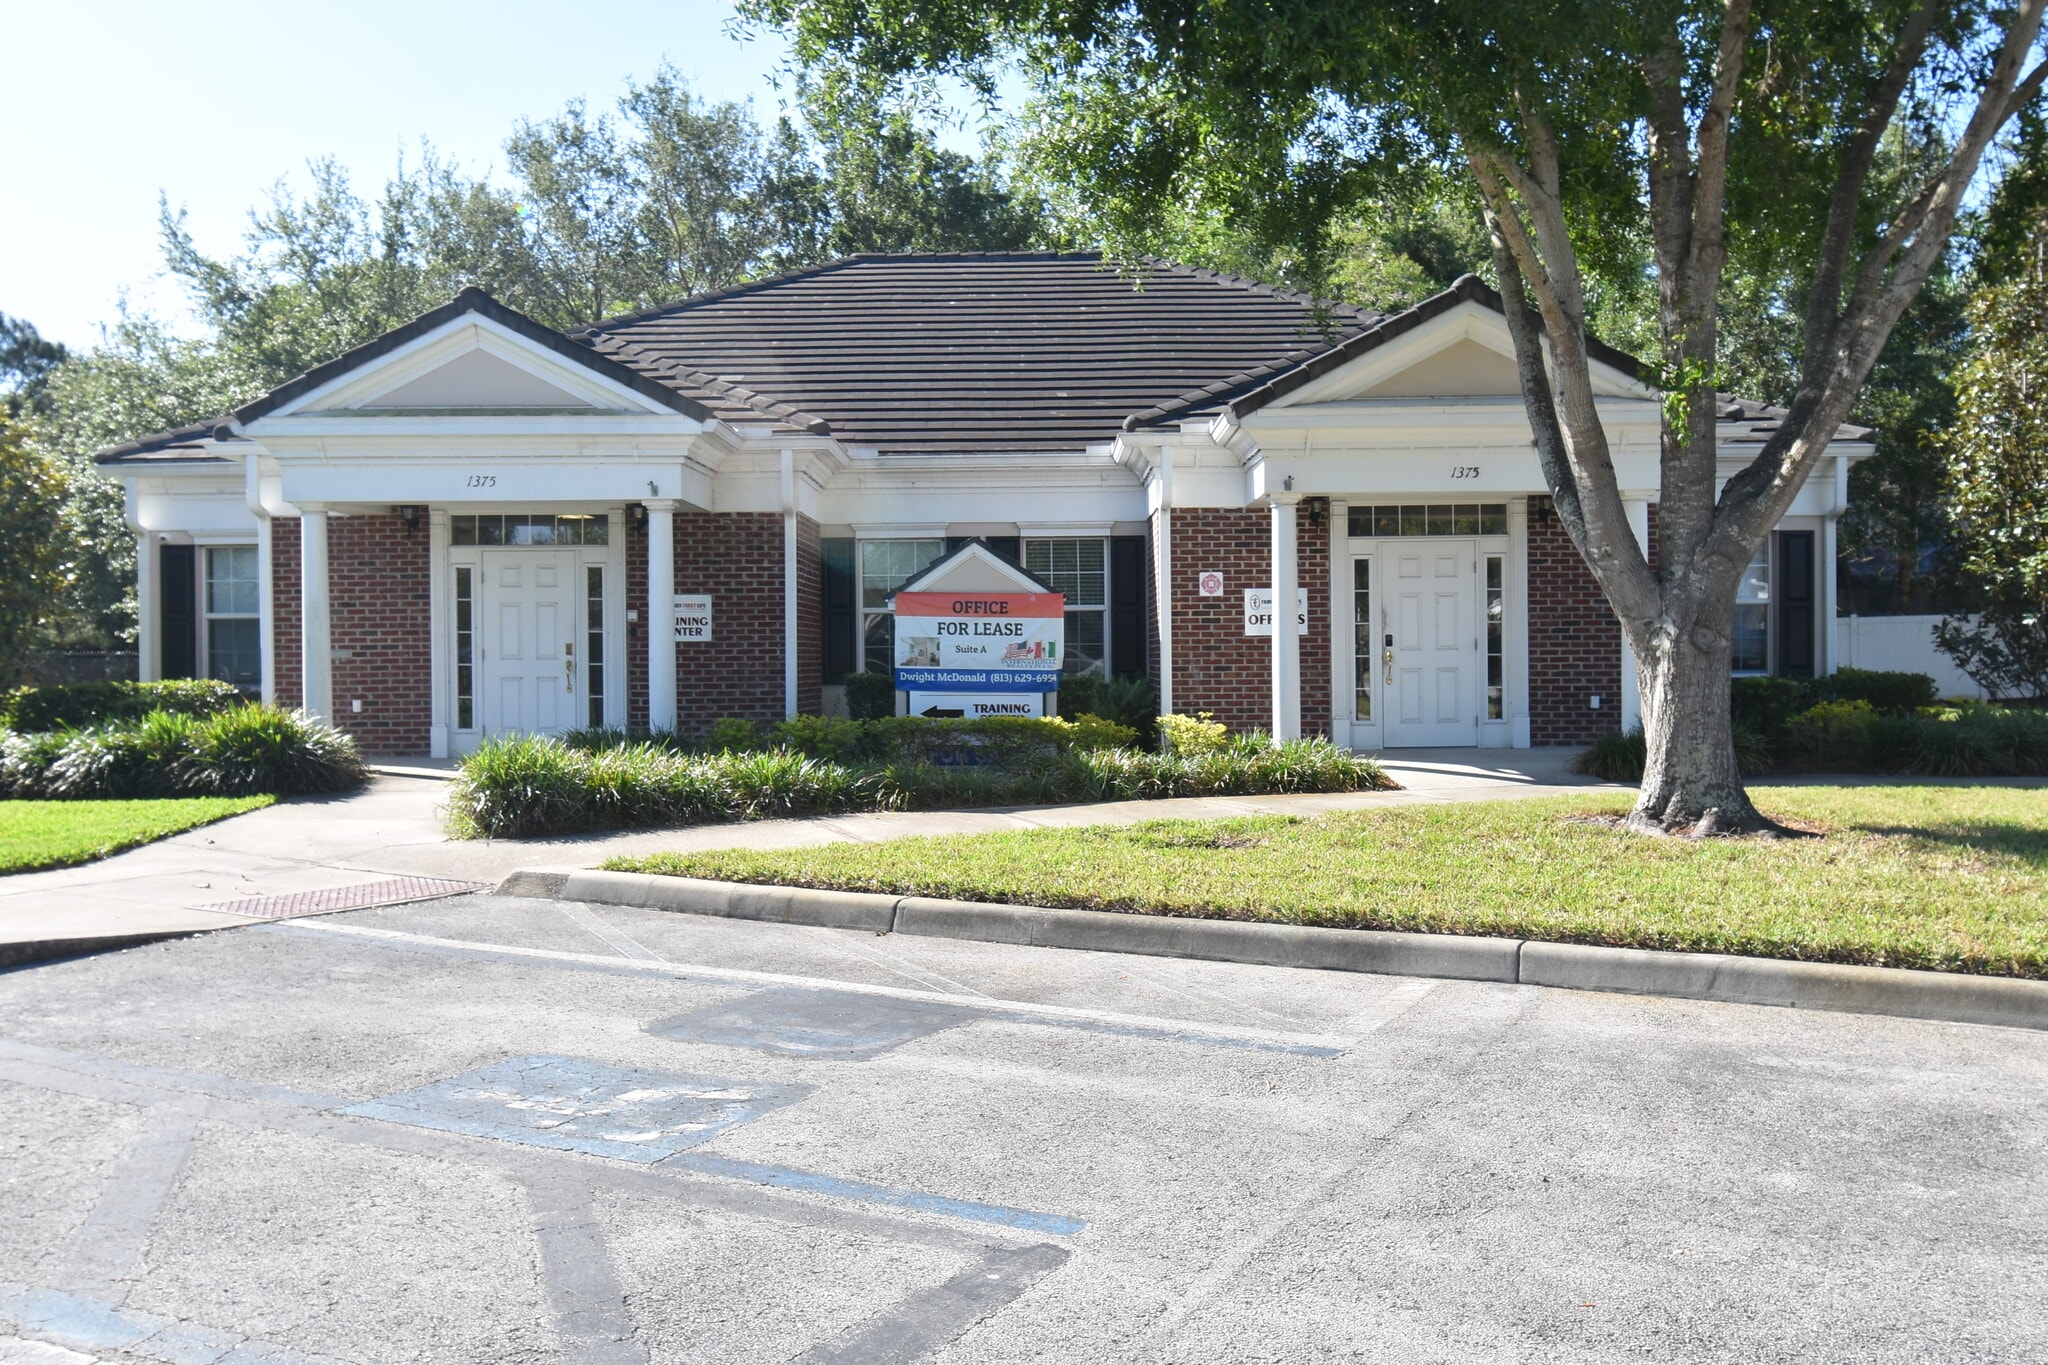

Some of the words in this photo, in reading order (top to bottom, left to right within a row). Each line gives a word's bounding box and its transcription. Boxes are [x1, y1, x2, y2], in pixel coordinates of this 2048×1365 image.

[1451, 466, 1480, 479] 1375
[466, 475, 497, 488] 1375
[952, 600, 1009, 614] OFFICE
[676, 616, 709, 626] INING
[1248, 613, 1306, 625] OFFS
[674, 627, 703, 636] NTER
[937, 621, 970, 636] FOR
[974, 622, 1024, 637] LEASE
[955, 645, 978, 654] Suite
[979, 645, 988, 654] A
[900, 671, 935, 684] Dwight
[937, 672, 986, 682] McDonald
[990, 673, 1013, 684] (813)
[1014, 673, 1057, 683] 629-6954
[973, 703, 1031, 713] TRAINING
